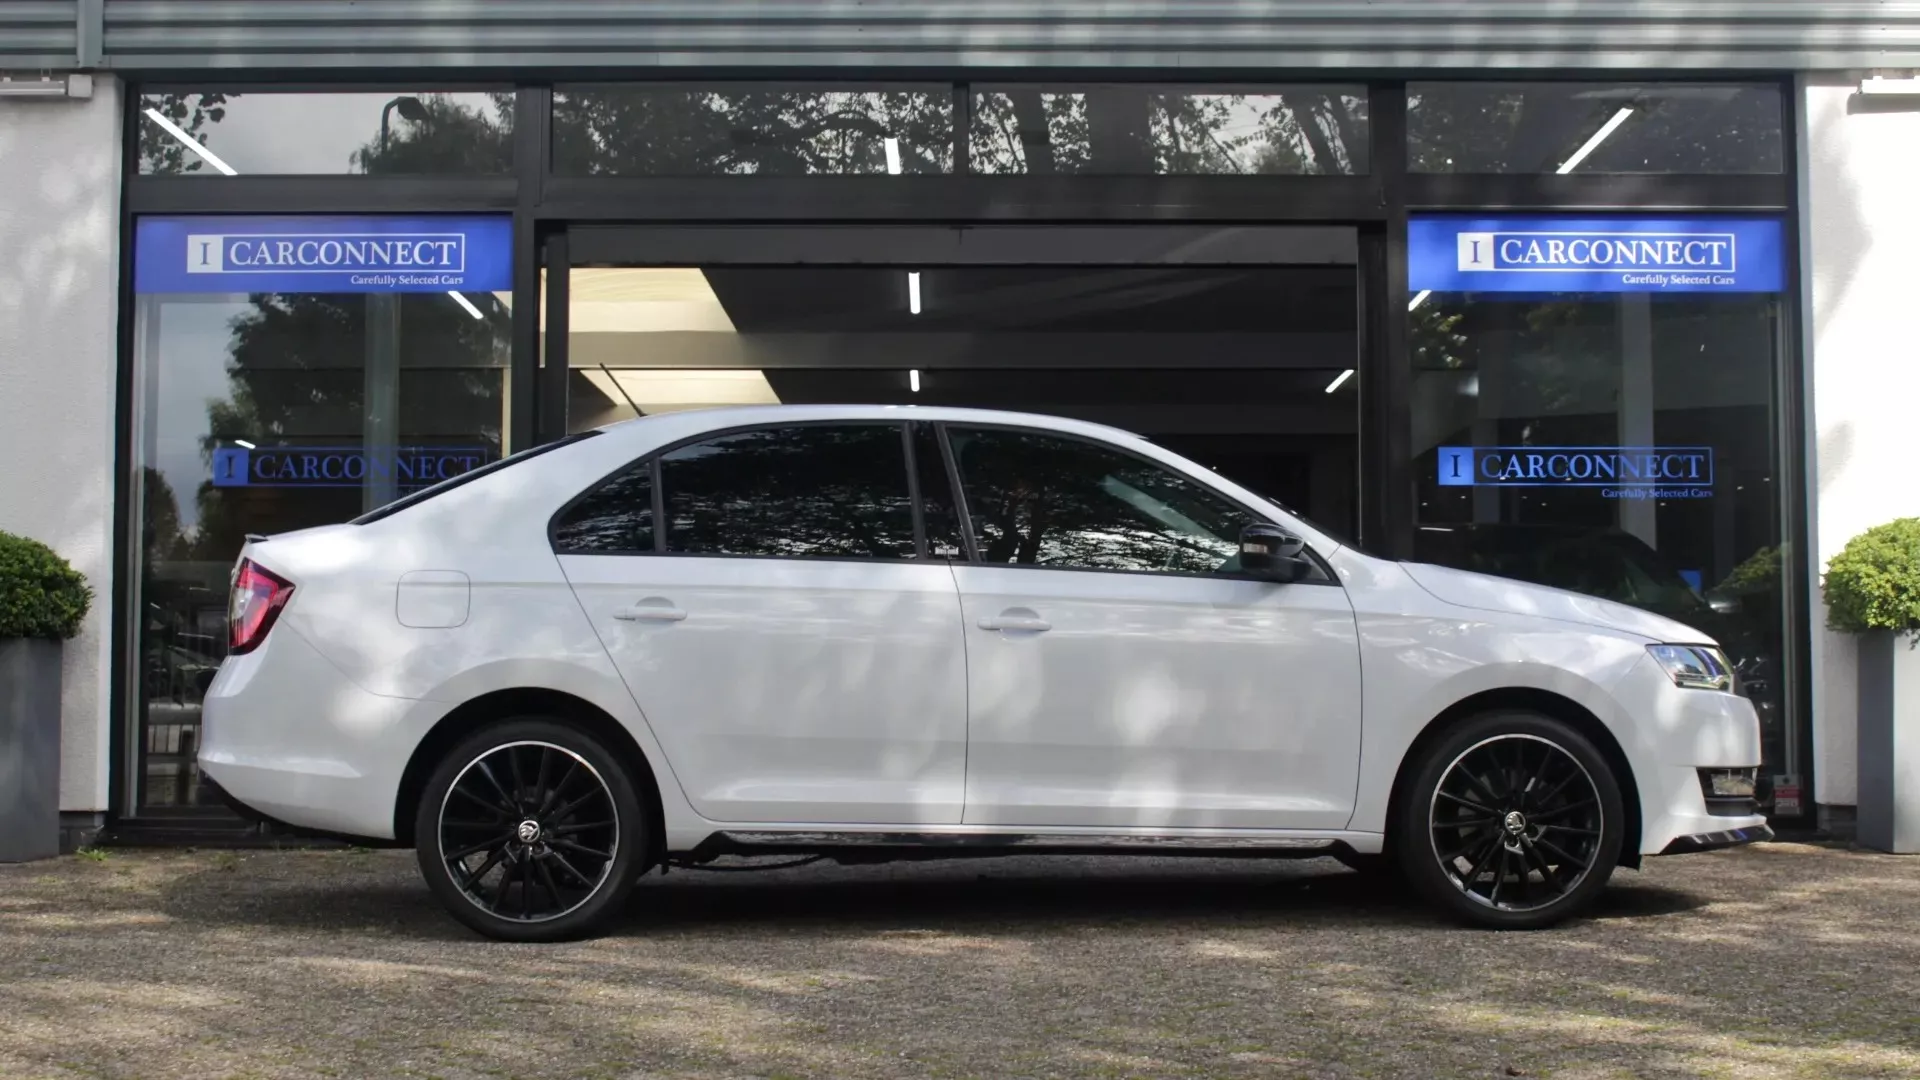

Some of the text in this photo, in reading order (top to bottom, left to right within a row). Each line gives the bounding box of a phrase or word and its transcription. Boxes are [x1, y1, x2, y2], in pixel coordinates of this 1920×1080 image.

[230, 241, 456, 265] CARCONNECT
[1501, 239, 1726, 265] CARCONNECT
[351, 275, 463, 287] Carefully Selected Cars
[1623, 274, 1735, 287] Carefully Selected Cars
[255, 455, 479, 479] CARCONNECT
[1481, 454, 1704, 478] CARCONNECT
[1602, 488, 1713, 500] Carefully Selected Cars
